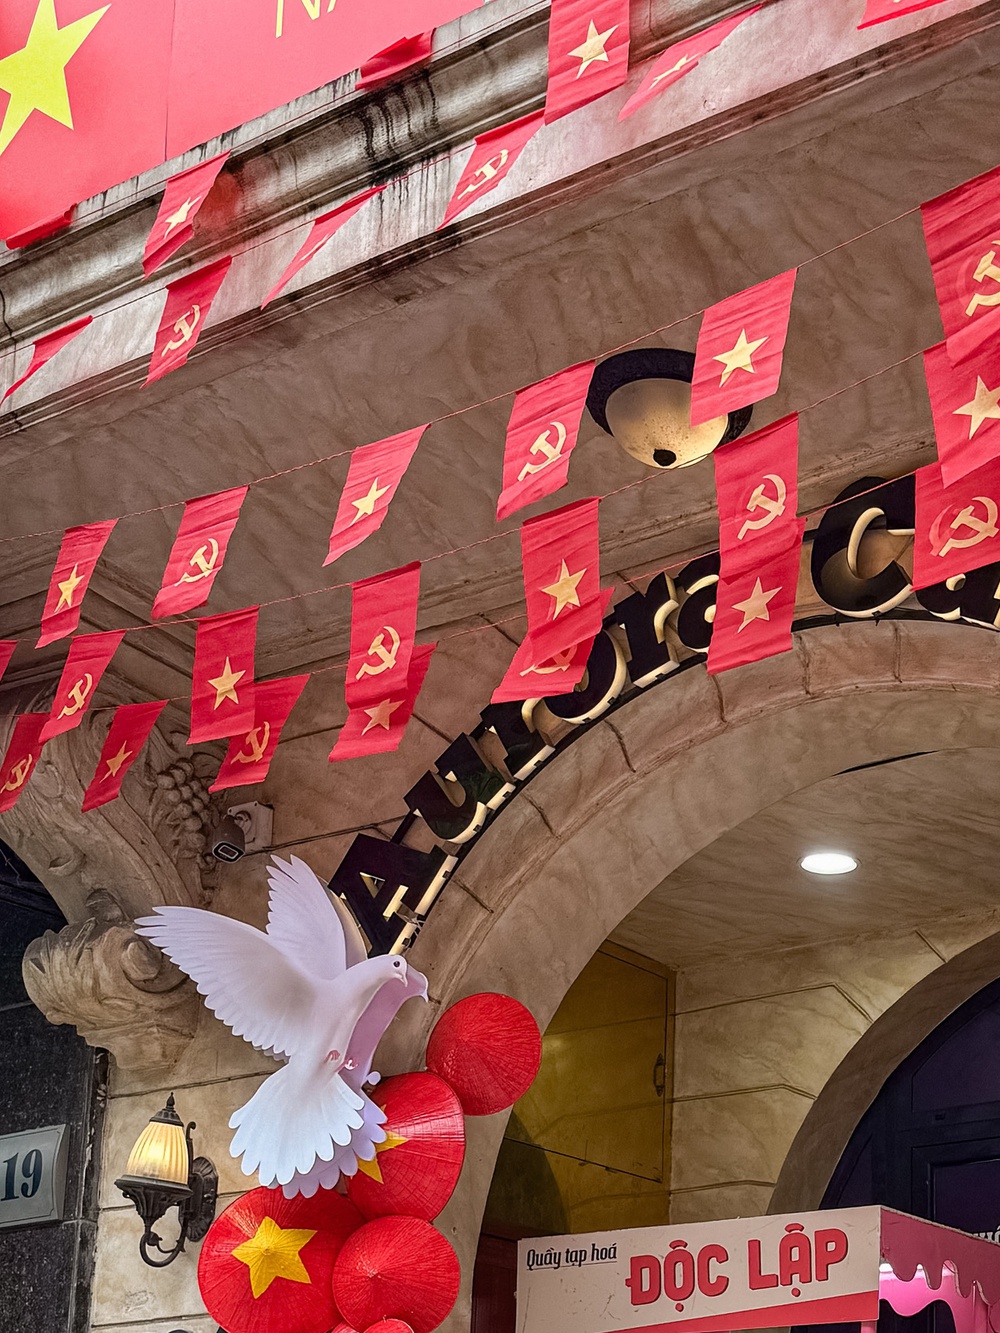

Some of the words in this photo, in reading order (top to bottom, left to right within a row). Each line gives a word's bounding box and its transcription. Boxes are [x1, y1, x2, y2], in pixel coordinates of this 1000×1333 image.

[3, 1148, 43, 1200] 19
[526, 1247, 561, 1271] Quầy
[565, 1248, 587, 1267] tạp
[591, 1242, 617, 1261] hoá
[625, 1239, 730, 1312] ĐỘC
[747, 1222, 848, 1297] LẬP
